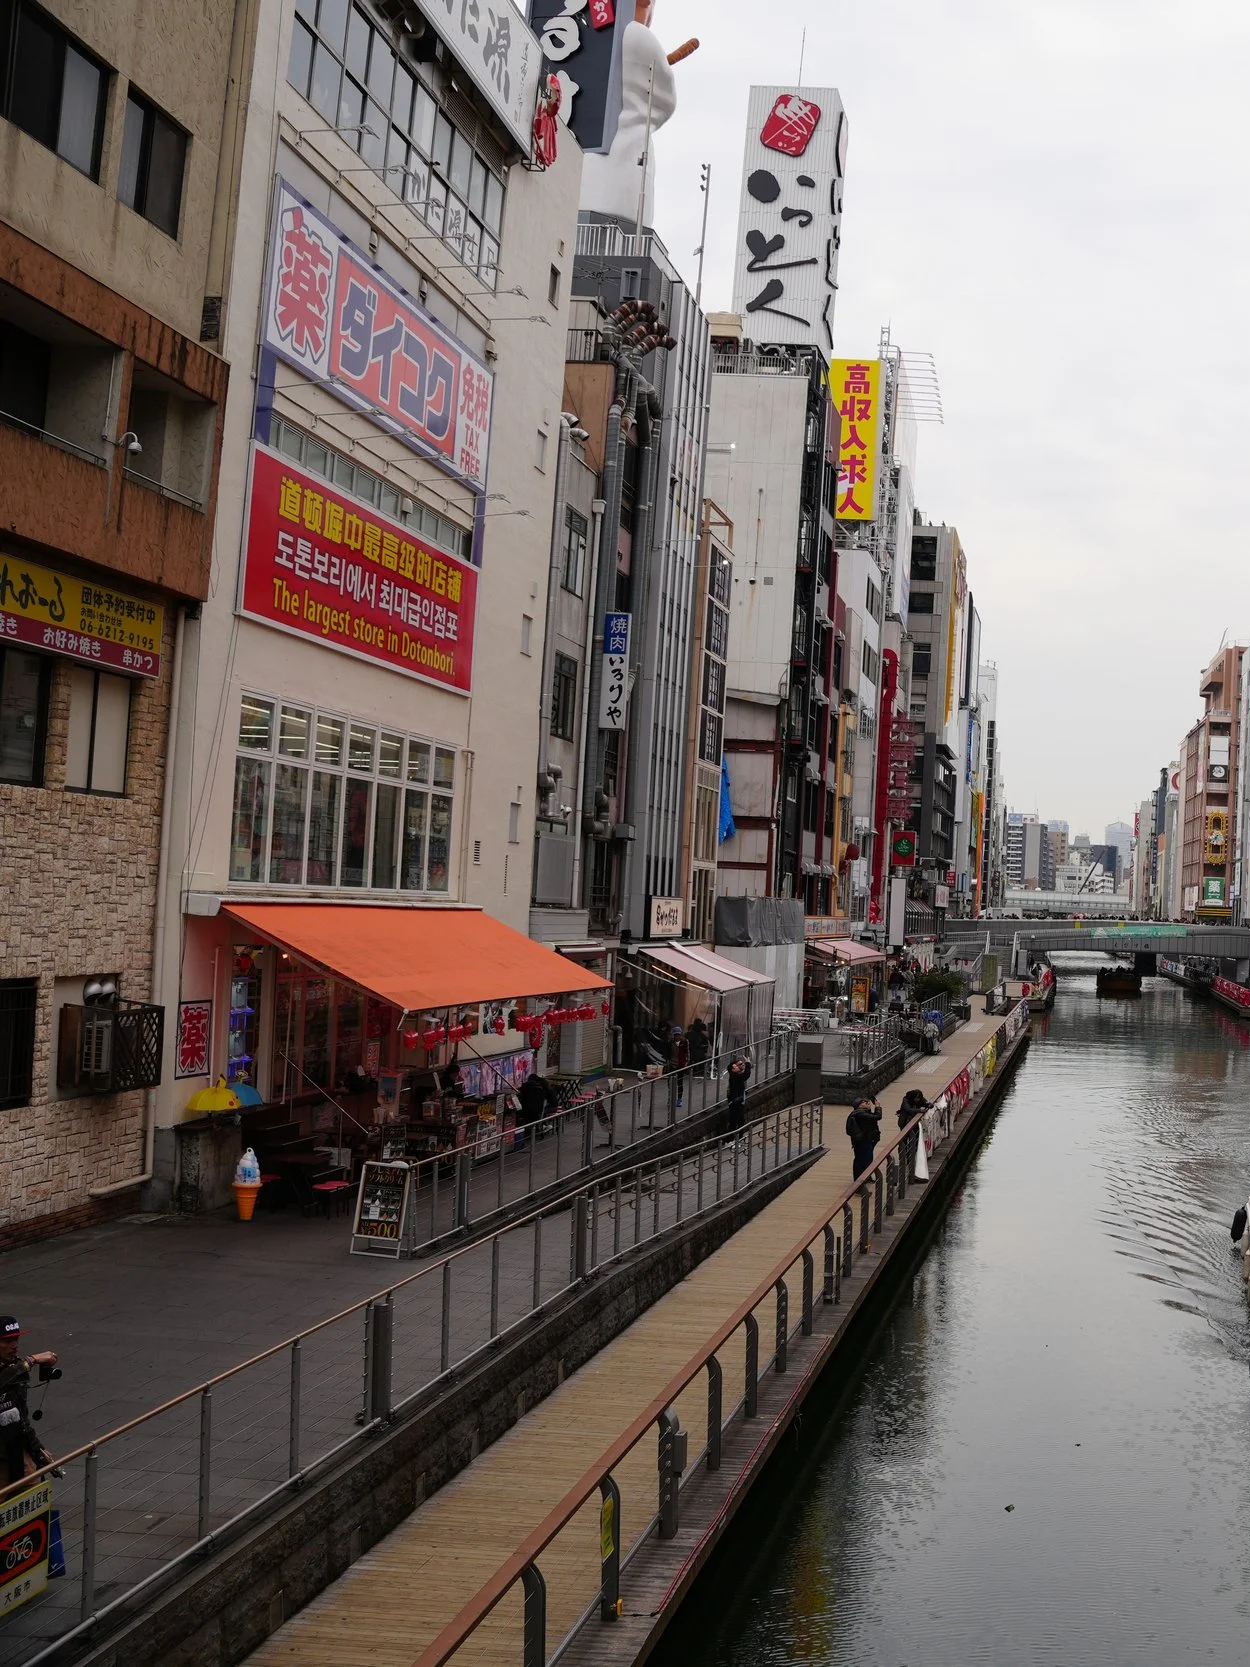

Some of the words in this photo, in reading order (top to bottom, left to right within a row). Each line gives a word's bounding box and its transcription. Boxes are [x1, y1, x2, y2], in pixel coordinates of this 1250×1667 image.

[277, 206, 332, 358] 薬
[339, 275, 456, 440] ダイコク
[459, 362, 490, 433] 免税
[460, 447, 480, 477] FREE
[465, 424, 480, 449] TAX
[838, 364, 872, 515] 高収入求人
[274, 530, 376, 609] 도톤보리에서
[79, 618, 155, 650] 06-6212-9195
[81, 585, 157, 625] 団体予約受付中
[272, 578, 299, 616] The
[304, 589, 350, 636] largest
[353, 616, 385, 649] store
[387, 625, 398, 653] in
[402, 631, 456, 677] Dotonbori.
[609, 616, 628, 652] 焼肉
[43, 627, 102, 658] お好み焼き
[122, 648, 154, 670] 串かつ
[606, 655, 625, 726] いろりや
[179, 1005, 209, 1074] 薬
[4, 1580, 32, 1606] 大阪市
